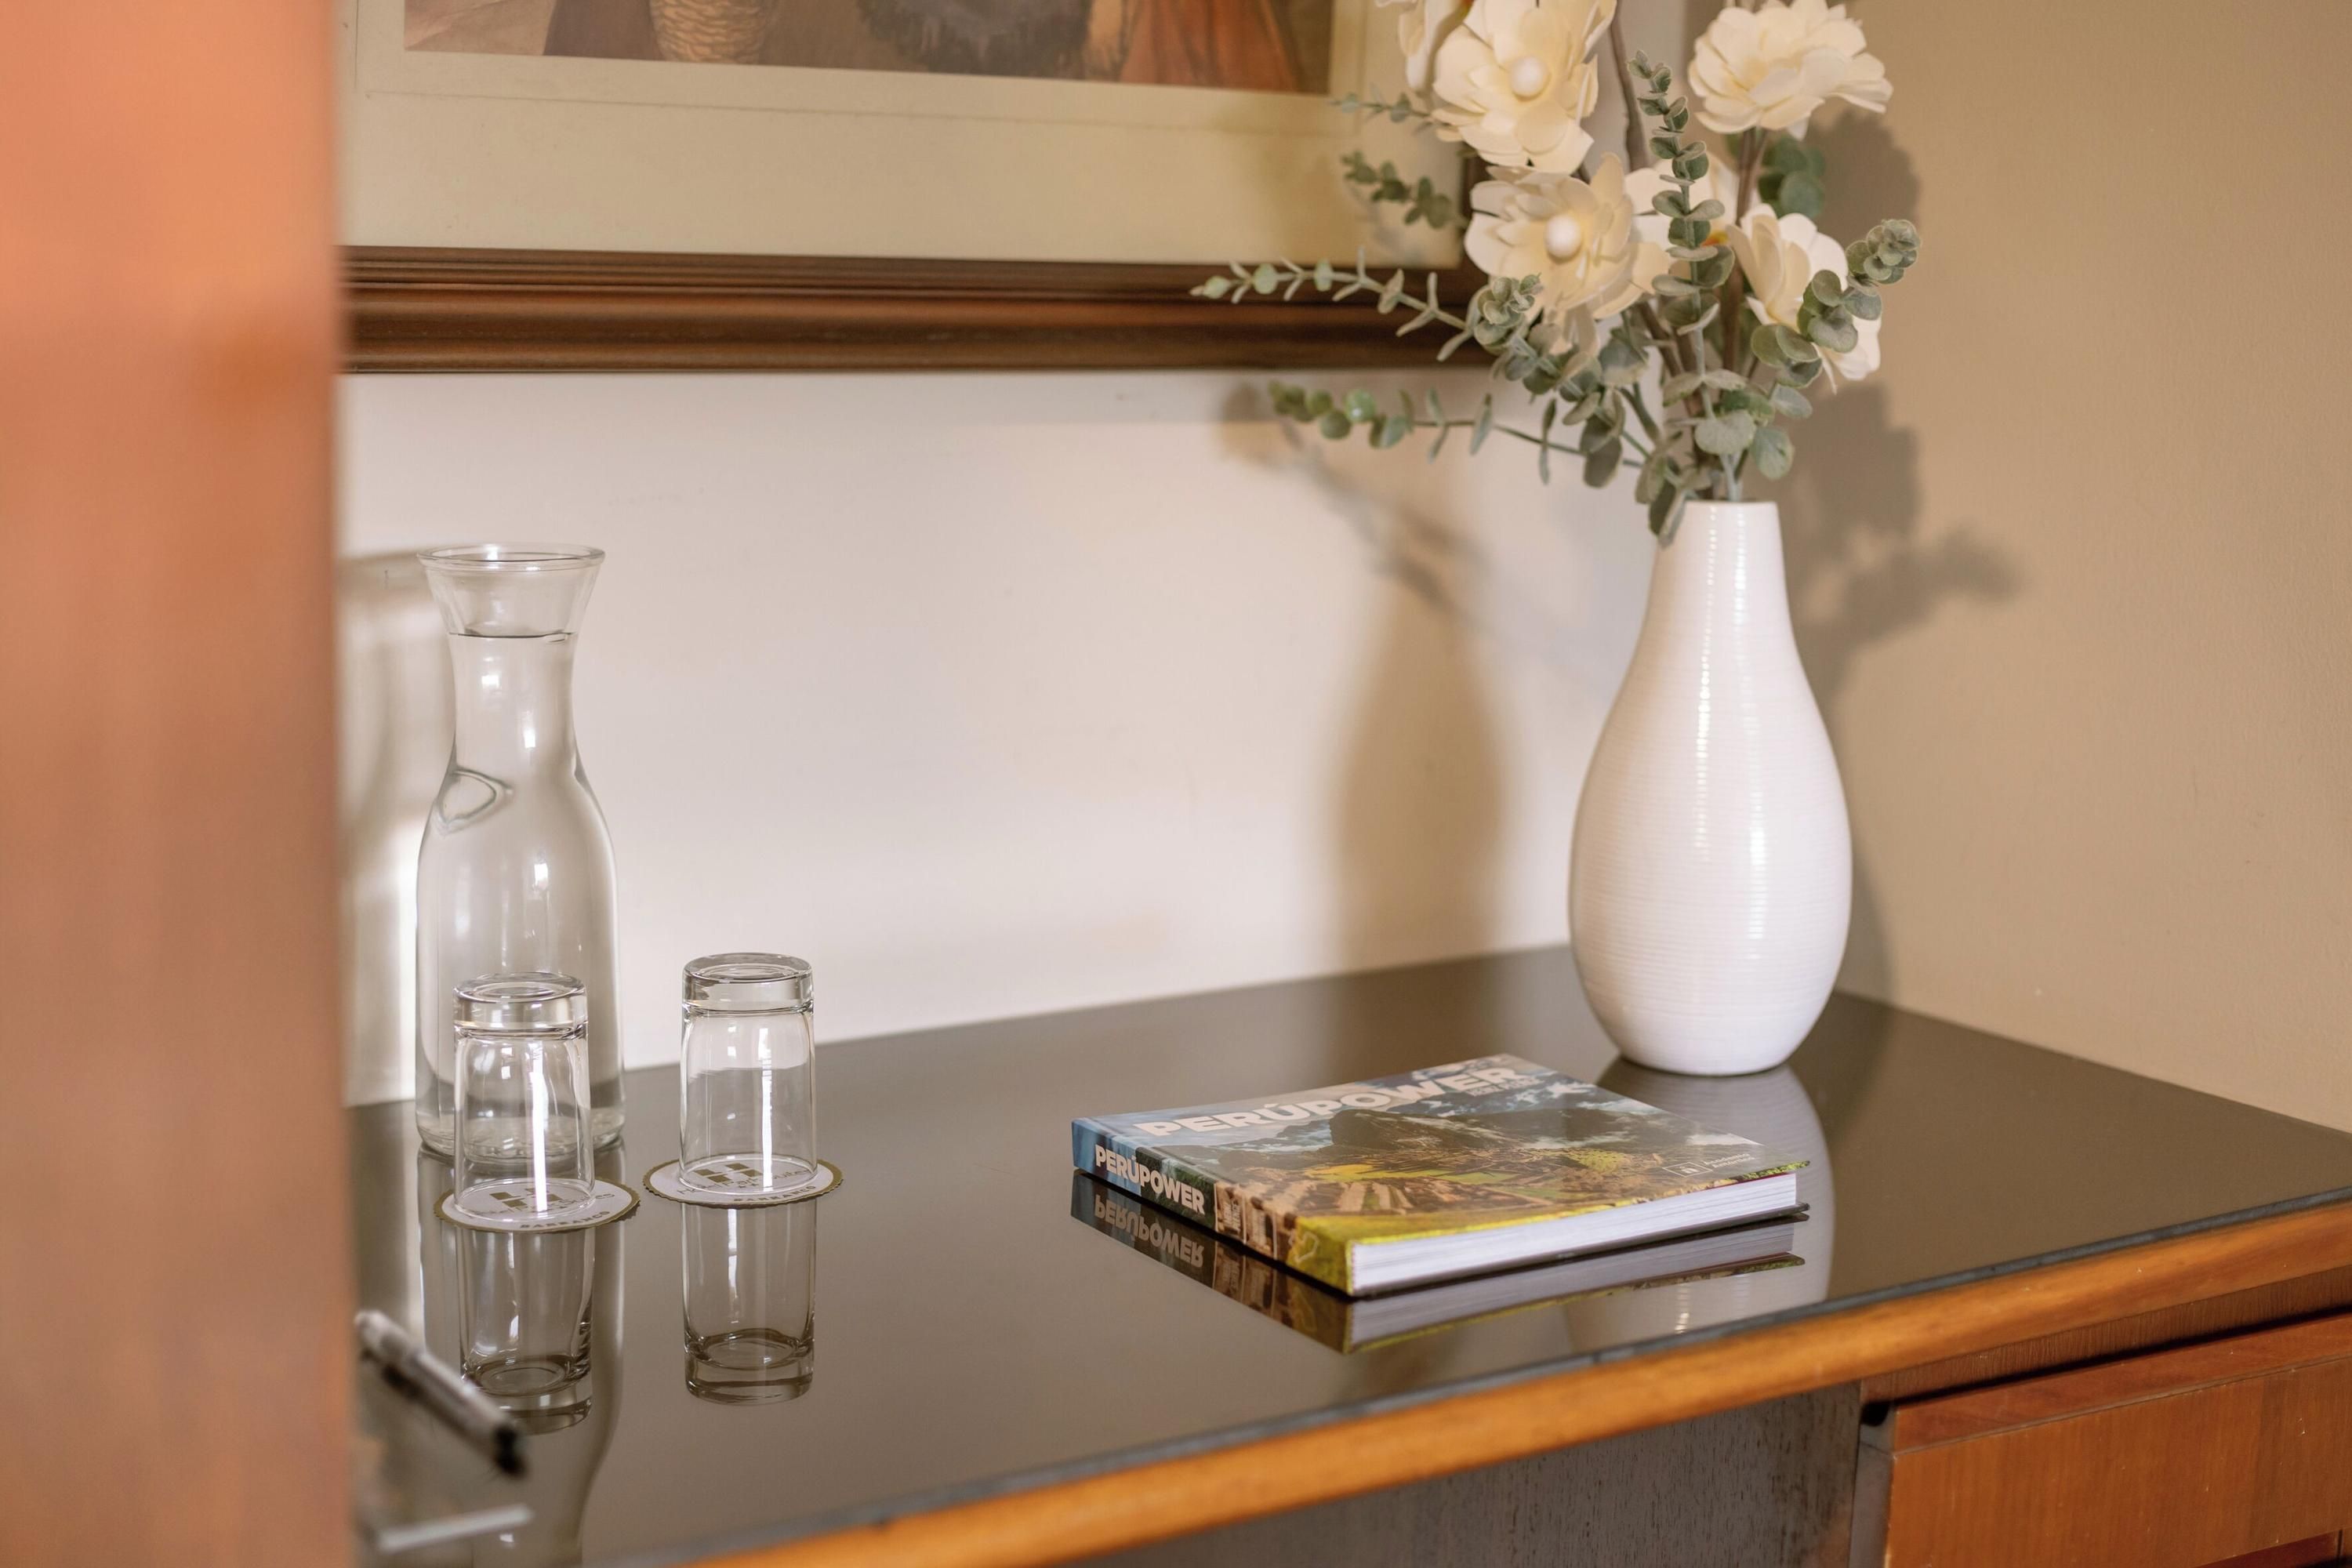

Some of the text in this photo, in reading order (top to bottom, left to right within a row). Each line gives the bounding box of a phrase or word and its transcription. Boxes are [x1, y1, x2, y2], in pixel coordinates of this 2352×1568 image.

[1132, 1067, 1532, 1136] PERÚPOWER
[733, 1185, 816, 1202] BARRANCO
[1094, 1144, 1205, 1215] PERÚPOWER
[520, 1210, 611, 1229] BARRANCO
